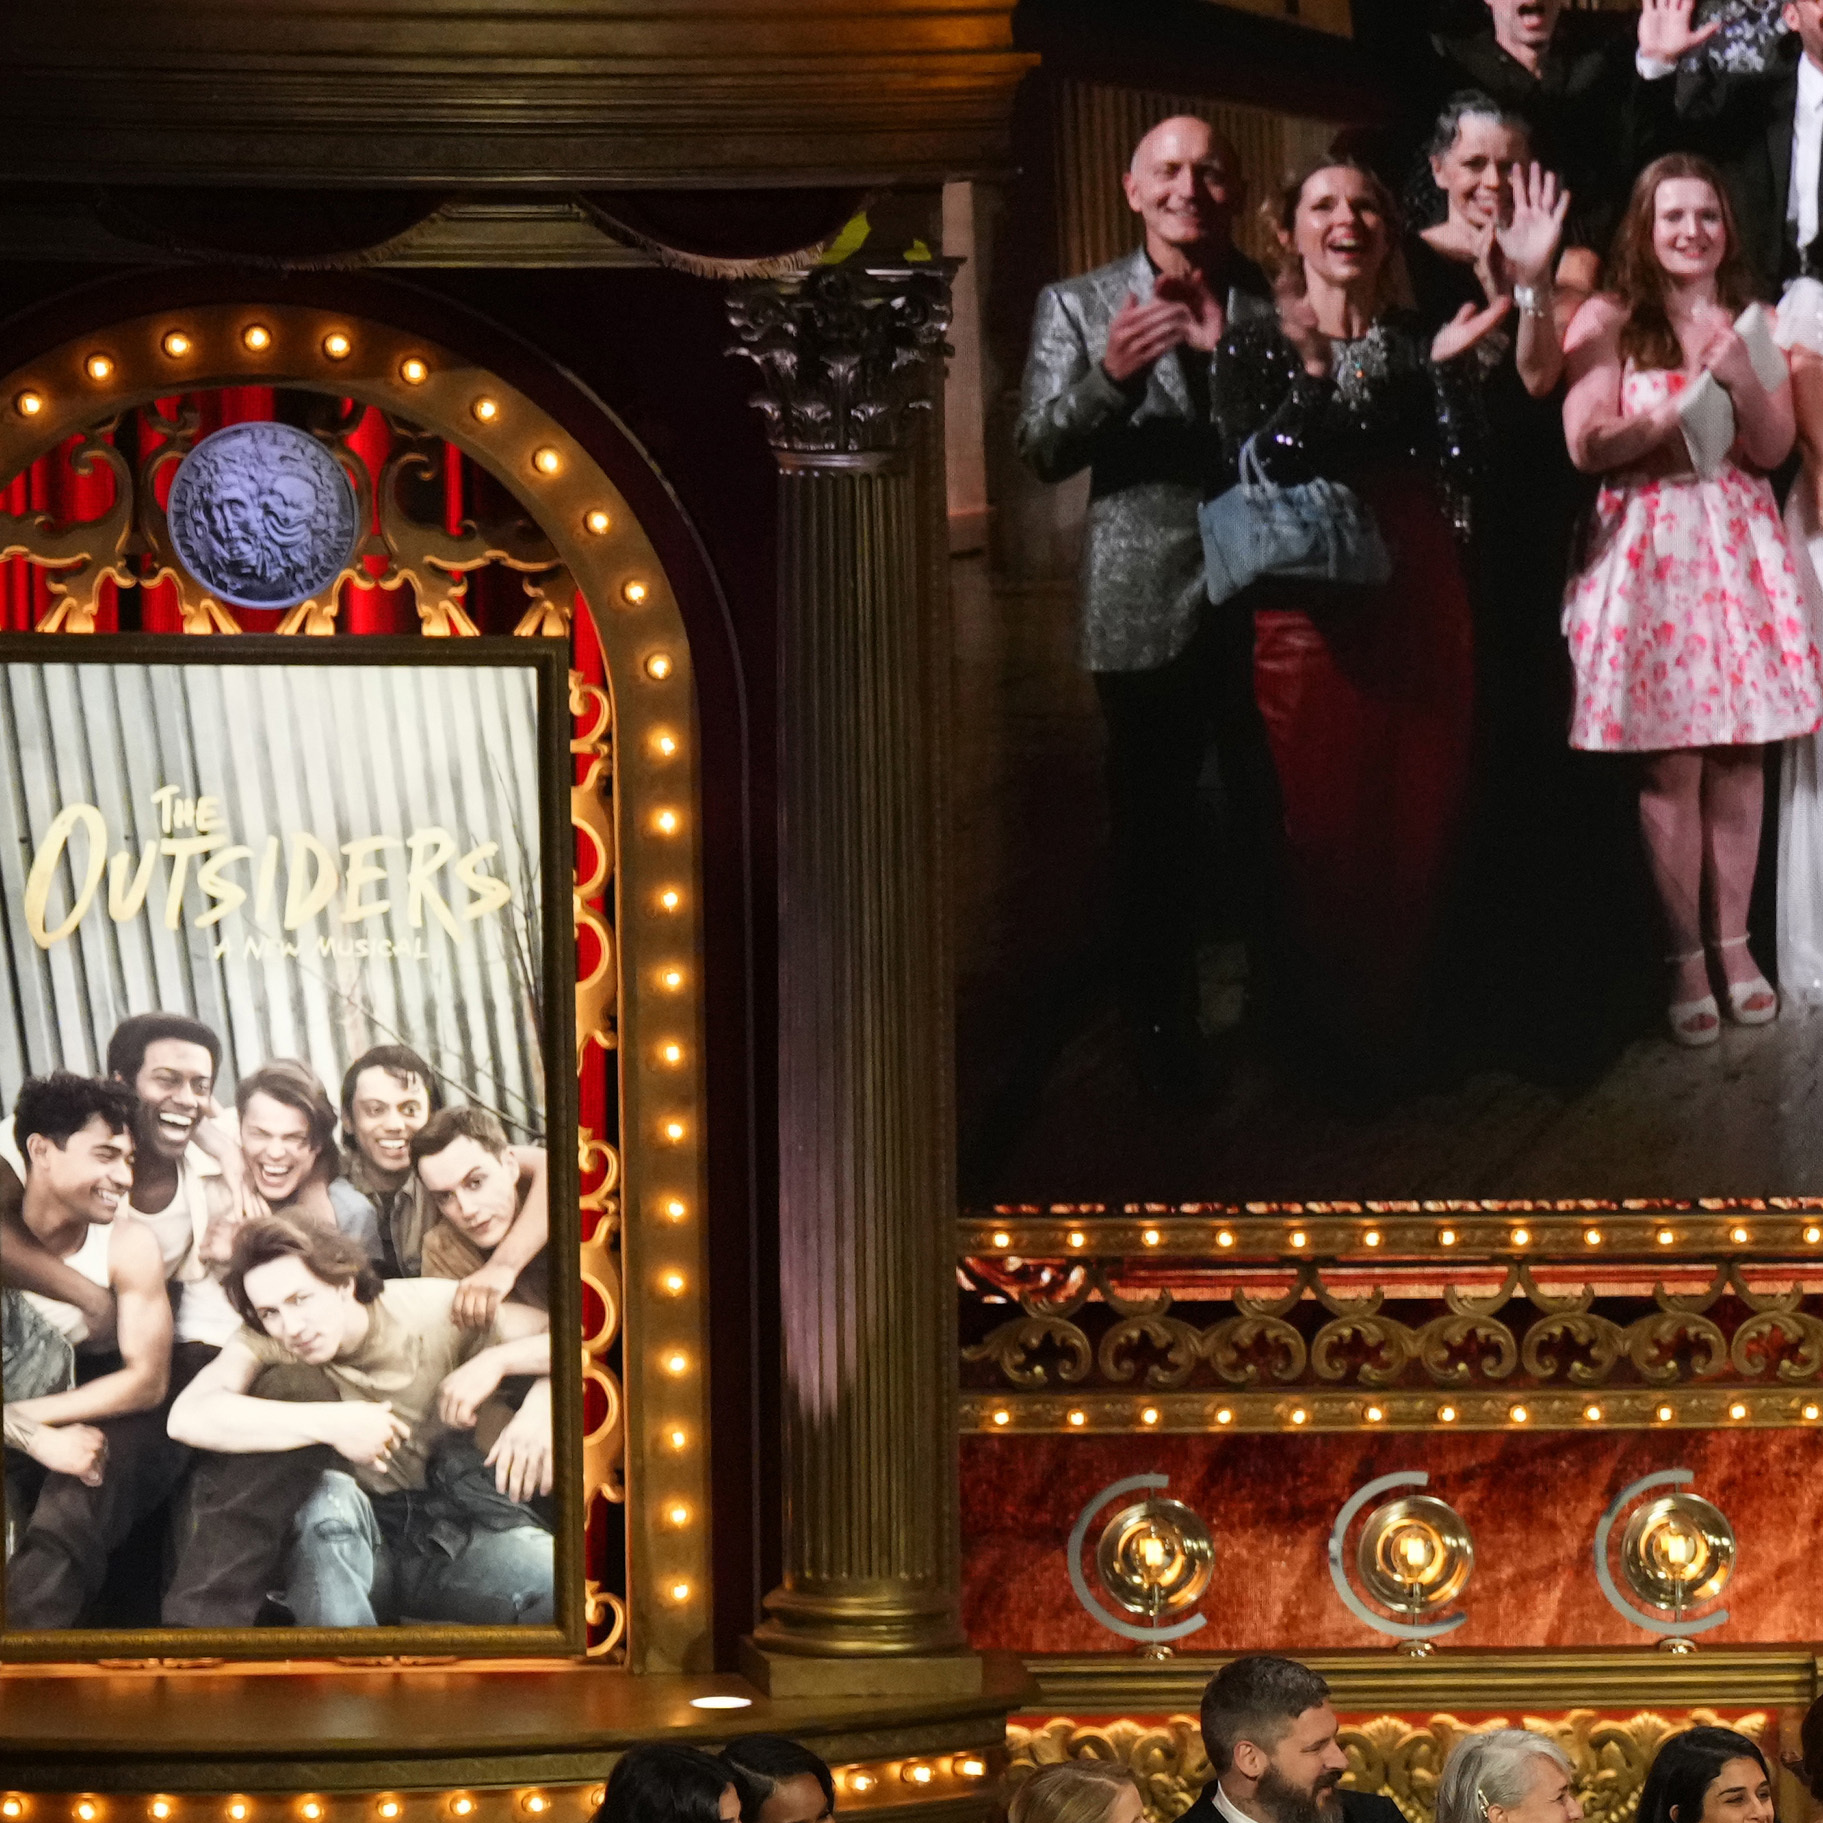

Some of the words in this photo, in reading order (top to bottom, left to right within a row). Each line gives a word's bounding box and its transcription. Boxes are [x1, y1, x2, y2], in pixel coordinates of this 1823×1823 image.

[151, 784, 224, 834] THE
[24, 803, 511, 949] OUTSIDERS
[317, 934, 430, 961] MUSICAL
